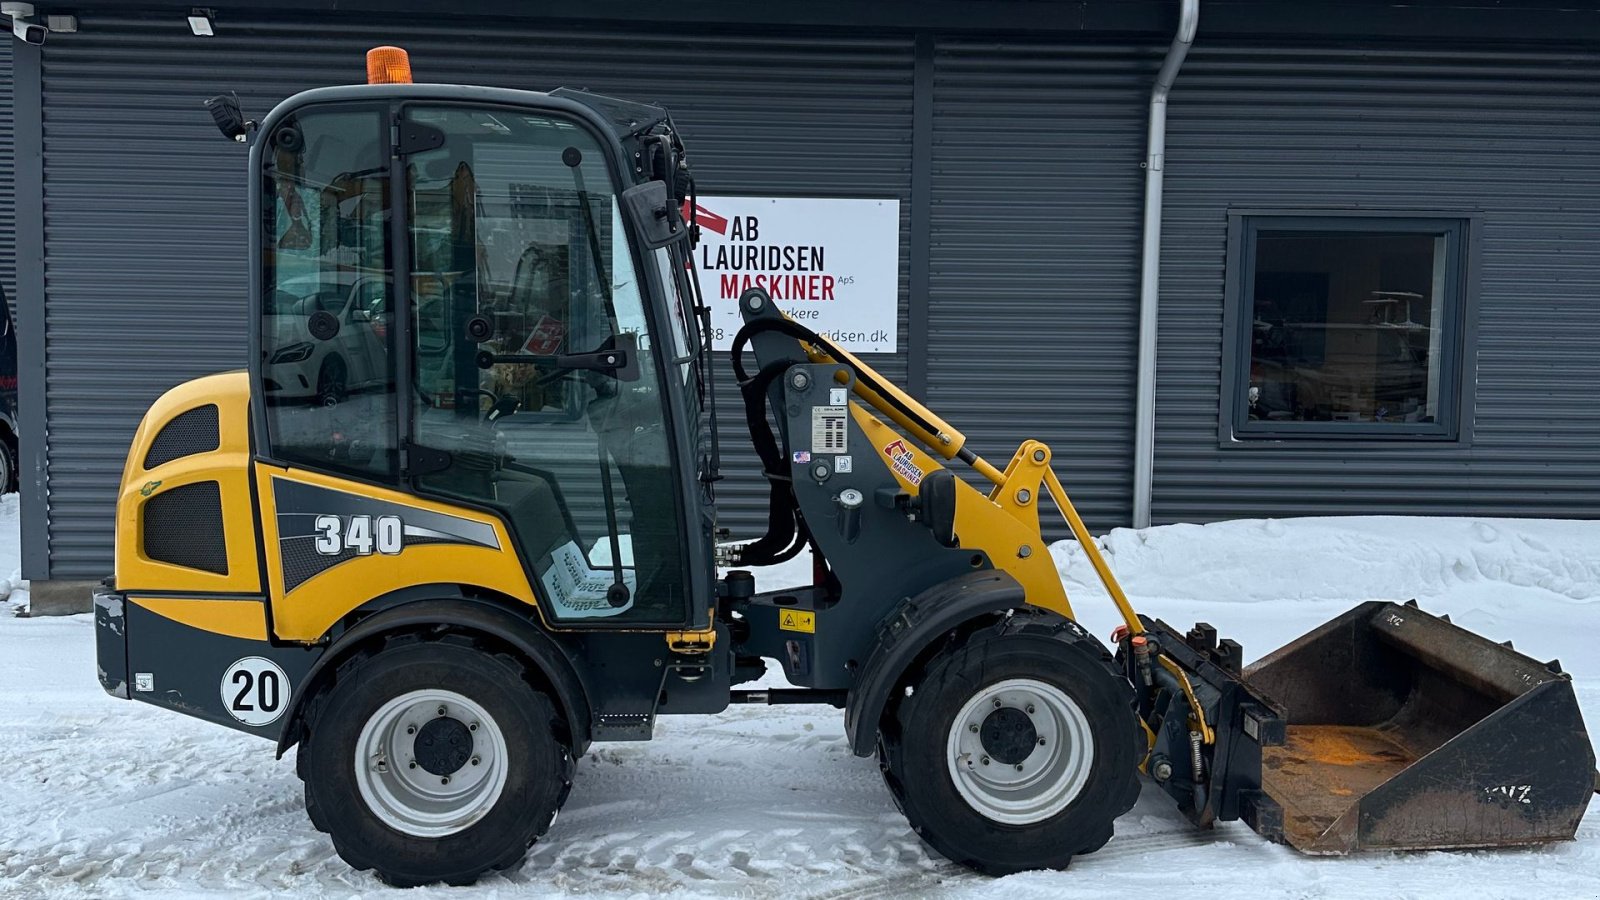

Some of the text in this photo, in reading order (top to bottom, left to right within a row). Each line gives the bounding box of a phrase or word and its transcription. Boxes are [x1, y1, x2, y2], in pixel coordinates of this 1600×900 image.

[730, 216, 759, 241] AB
[703, 244, 824, 271] LAURIDSEN
[837, 276, 855, 285] ApS
[893, 453, 923, 478] LAURIDSEN
[893, 463, 920, 485] MASKINER
[315, 514, 403, 555] 340
[232, 669, 280, 712] 20
